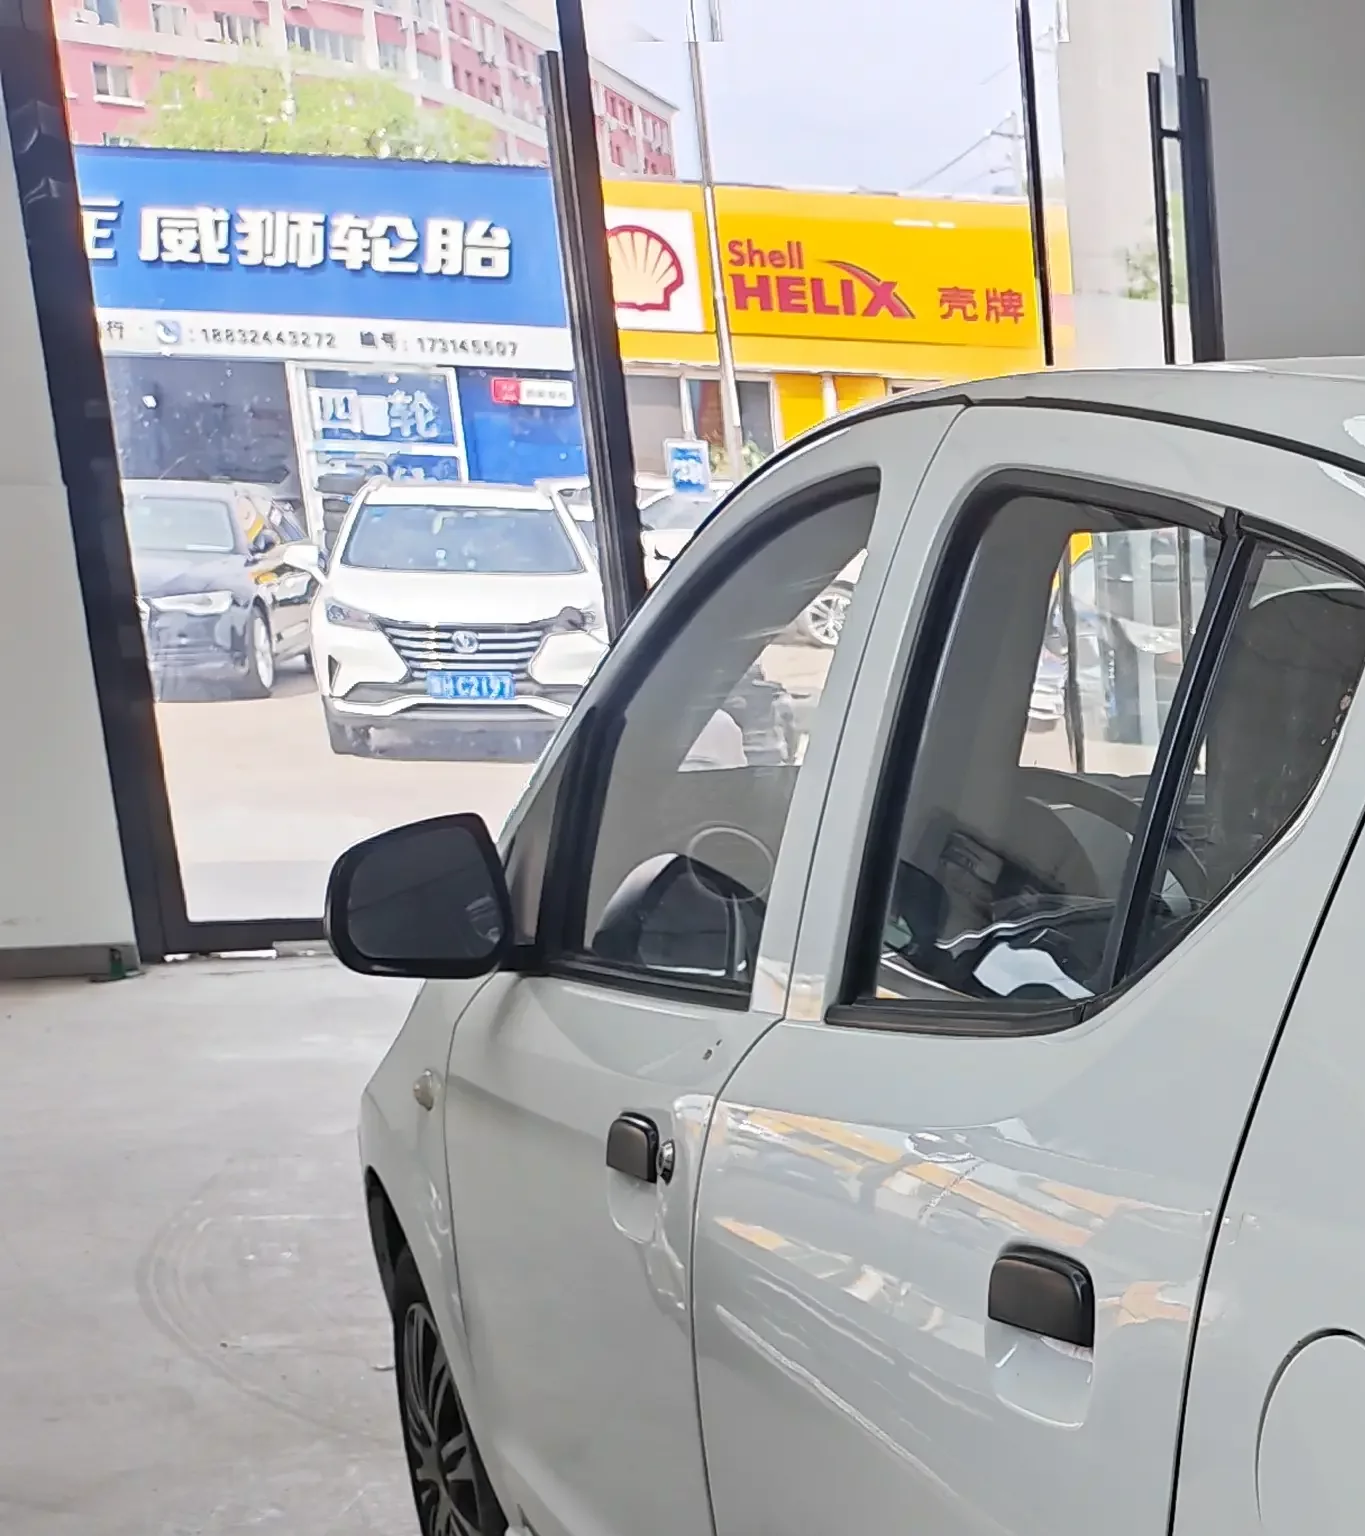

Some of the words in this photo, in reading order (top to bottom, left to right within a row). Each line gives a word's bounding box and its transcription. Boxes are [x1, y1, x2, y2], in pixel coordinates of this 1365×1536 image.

[139, 204, 511, 279] 威狮轮胎
[727, 238, 804, 270] Shell
[728, 271, 916, 320] HELIX
[937, 285, 1025, 324] 壳牌
